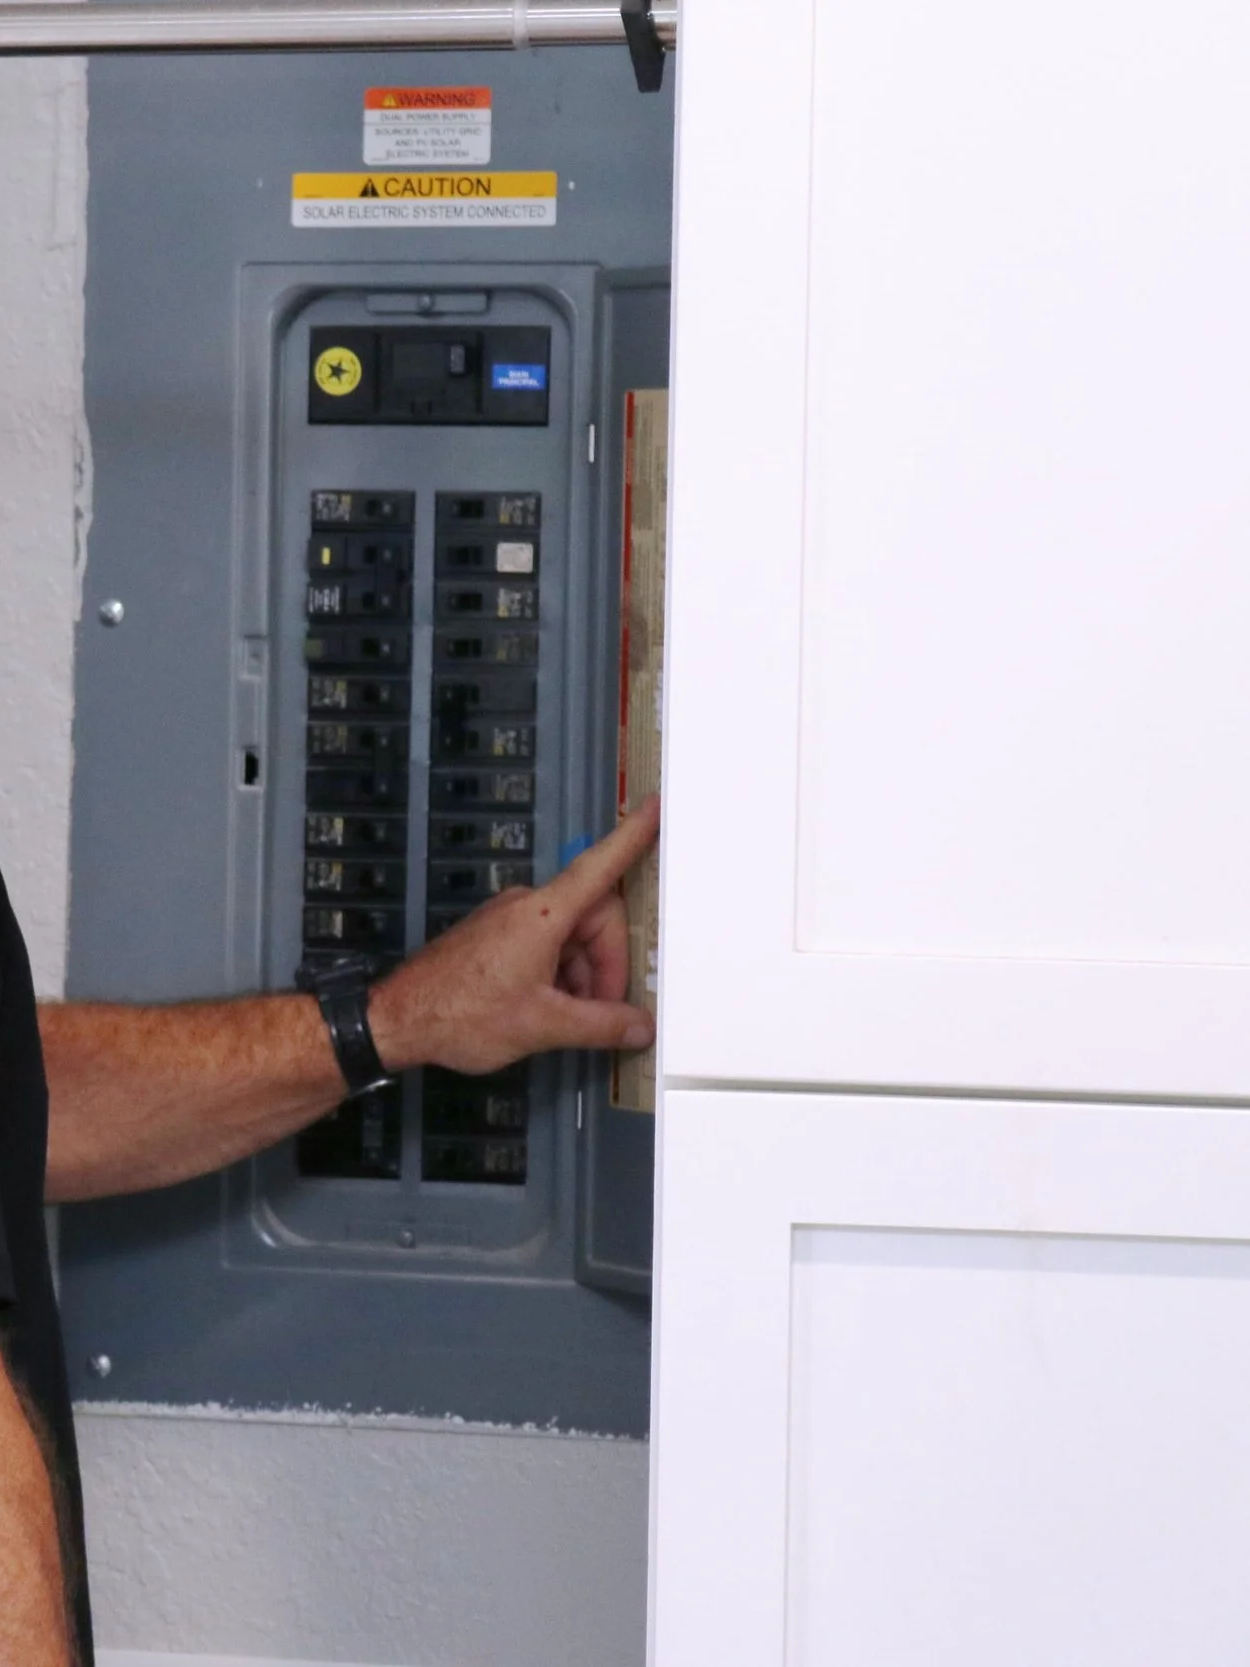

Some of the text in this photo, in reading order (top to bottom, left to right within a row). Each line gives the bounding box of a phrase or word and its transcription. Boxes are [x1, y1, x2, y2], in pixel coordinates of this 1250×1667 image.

[400, 92, 476, 106] WARNING
[406, 113, 440, 121] POWER
[442, 113, 477, 121] SUPPLY
[395, 138, 414, 147] AND
[431, 138, 461, 147] SOLAR
[386, 149, 470, 158] ELECTRIC SYSTEM
[384, 177, 492, 197] CAUTION
[303, 205, 547, 219] SOLAR ELECTRIC SYSTEM CONNECTED
